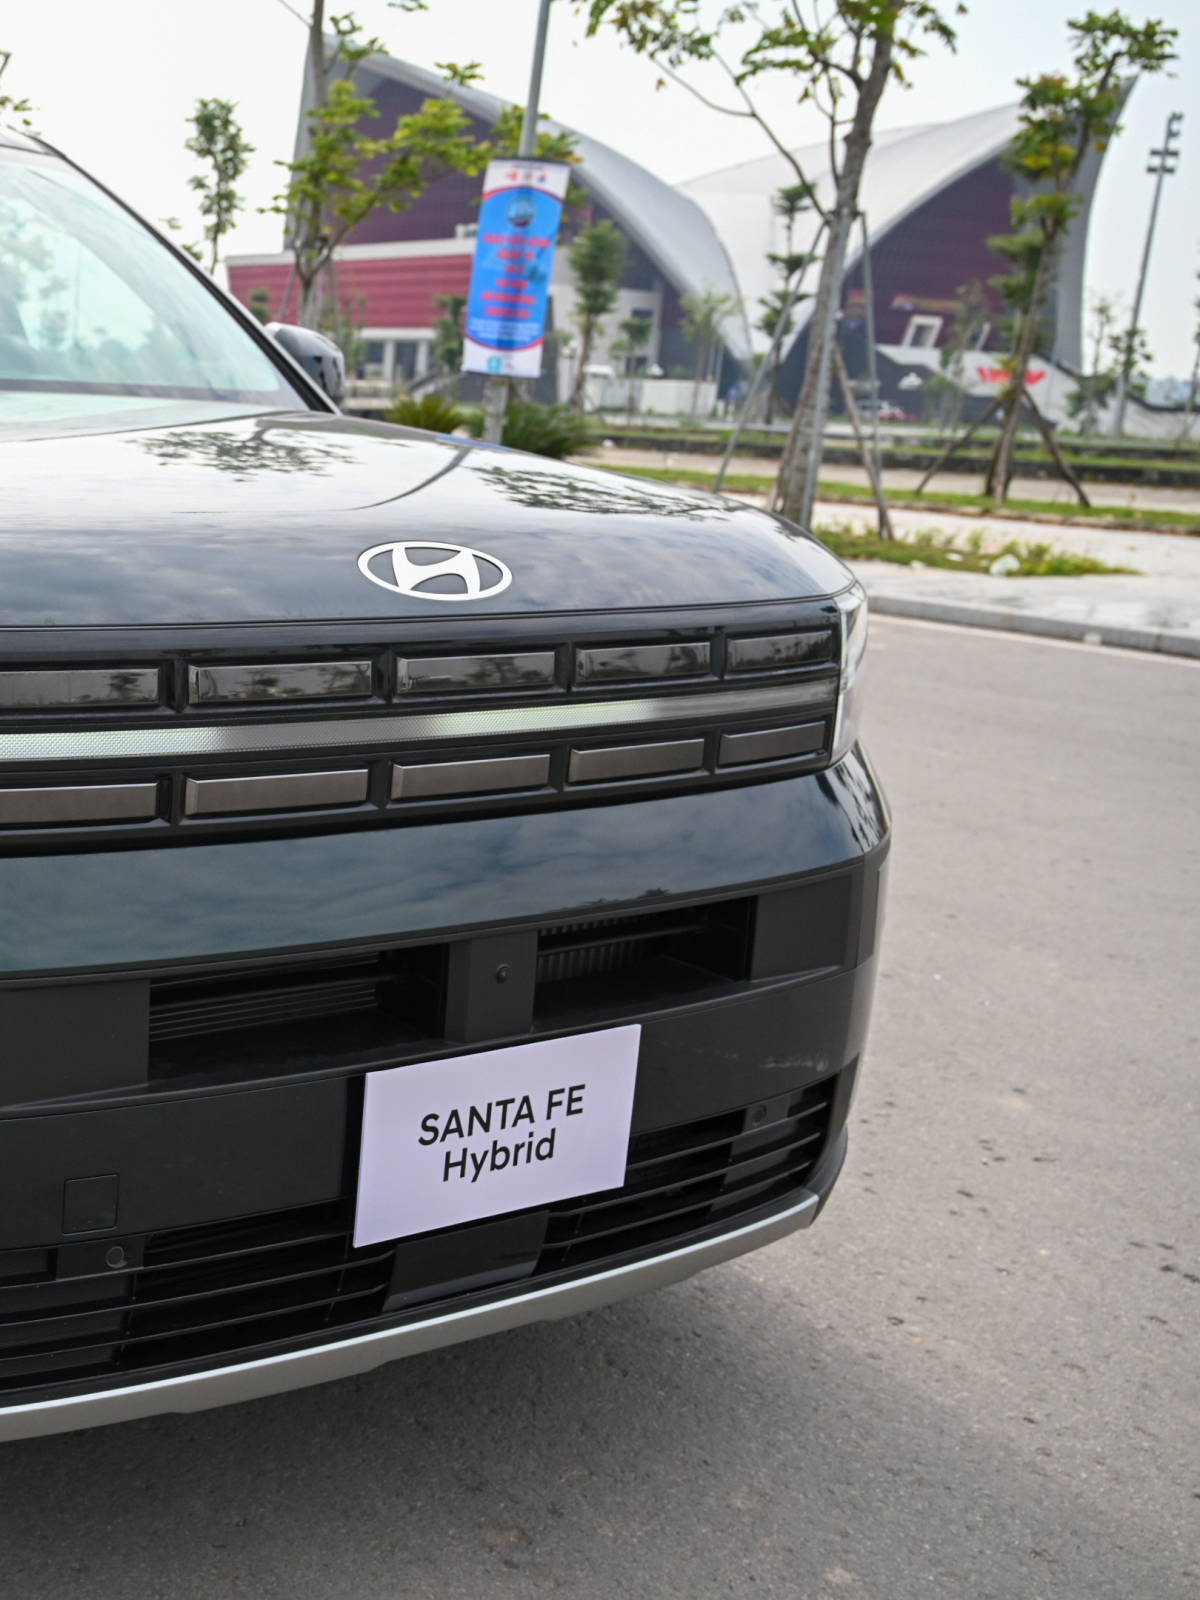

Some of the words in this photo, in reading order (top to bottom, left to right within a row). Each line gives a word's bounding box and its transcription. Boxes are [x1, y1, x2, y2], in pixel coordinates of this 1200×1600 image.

[418, 1094, 536, 1146] SANTA
[545, 1083, 586, 1120] FE
[442, 1127, 557, 1183] Hybrid
